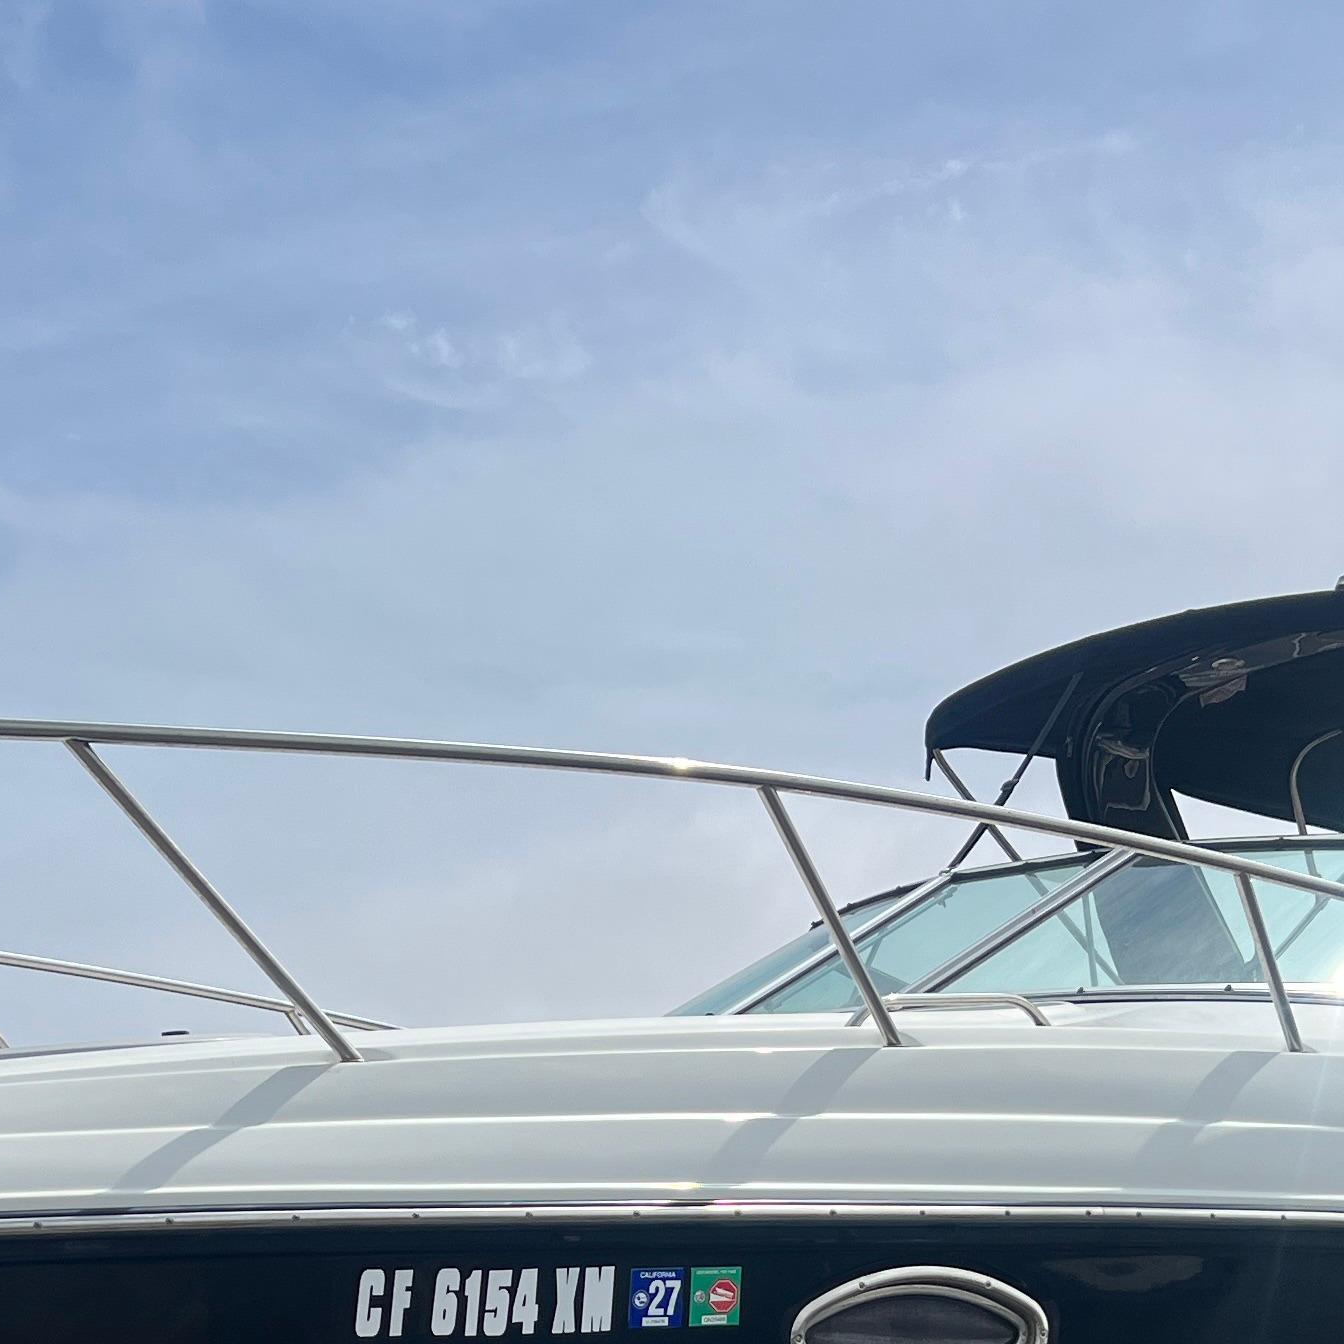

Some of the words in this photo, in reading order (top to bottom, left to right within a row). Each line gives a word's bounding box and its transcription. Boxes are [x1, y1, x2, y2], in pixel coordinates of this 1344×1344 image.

[355, 1268, 414, 1338] CF
[430, 1267, 539, 1337] 6154
[551, 1265, 616, 1335] XM
[647, 1279, 682, 1316] 27
